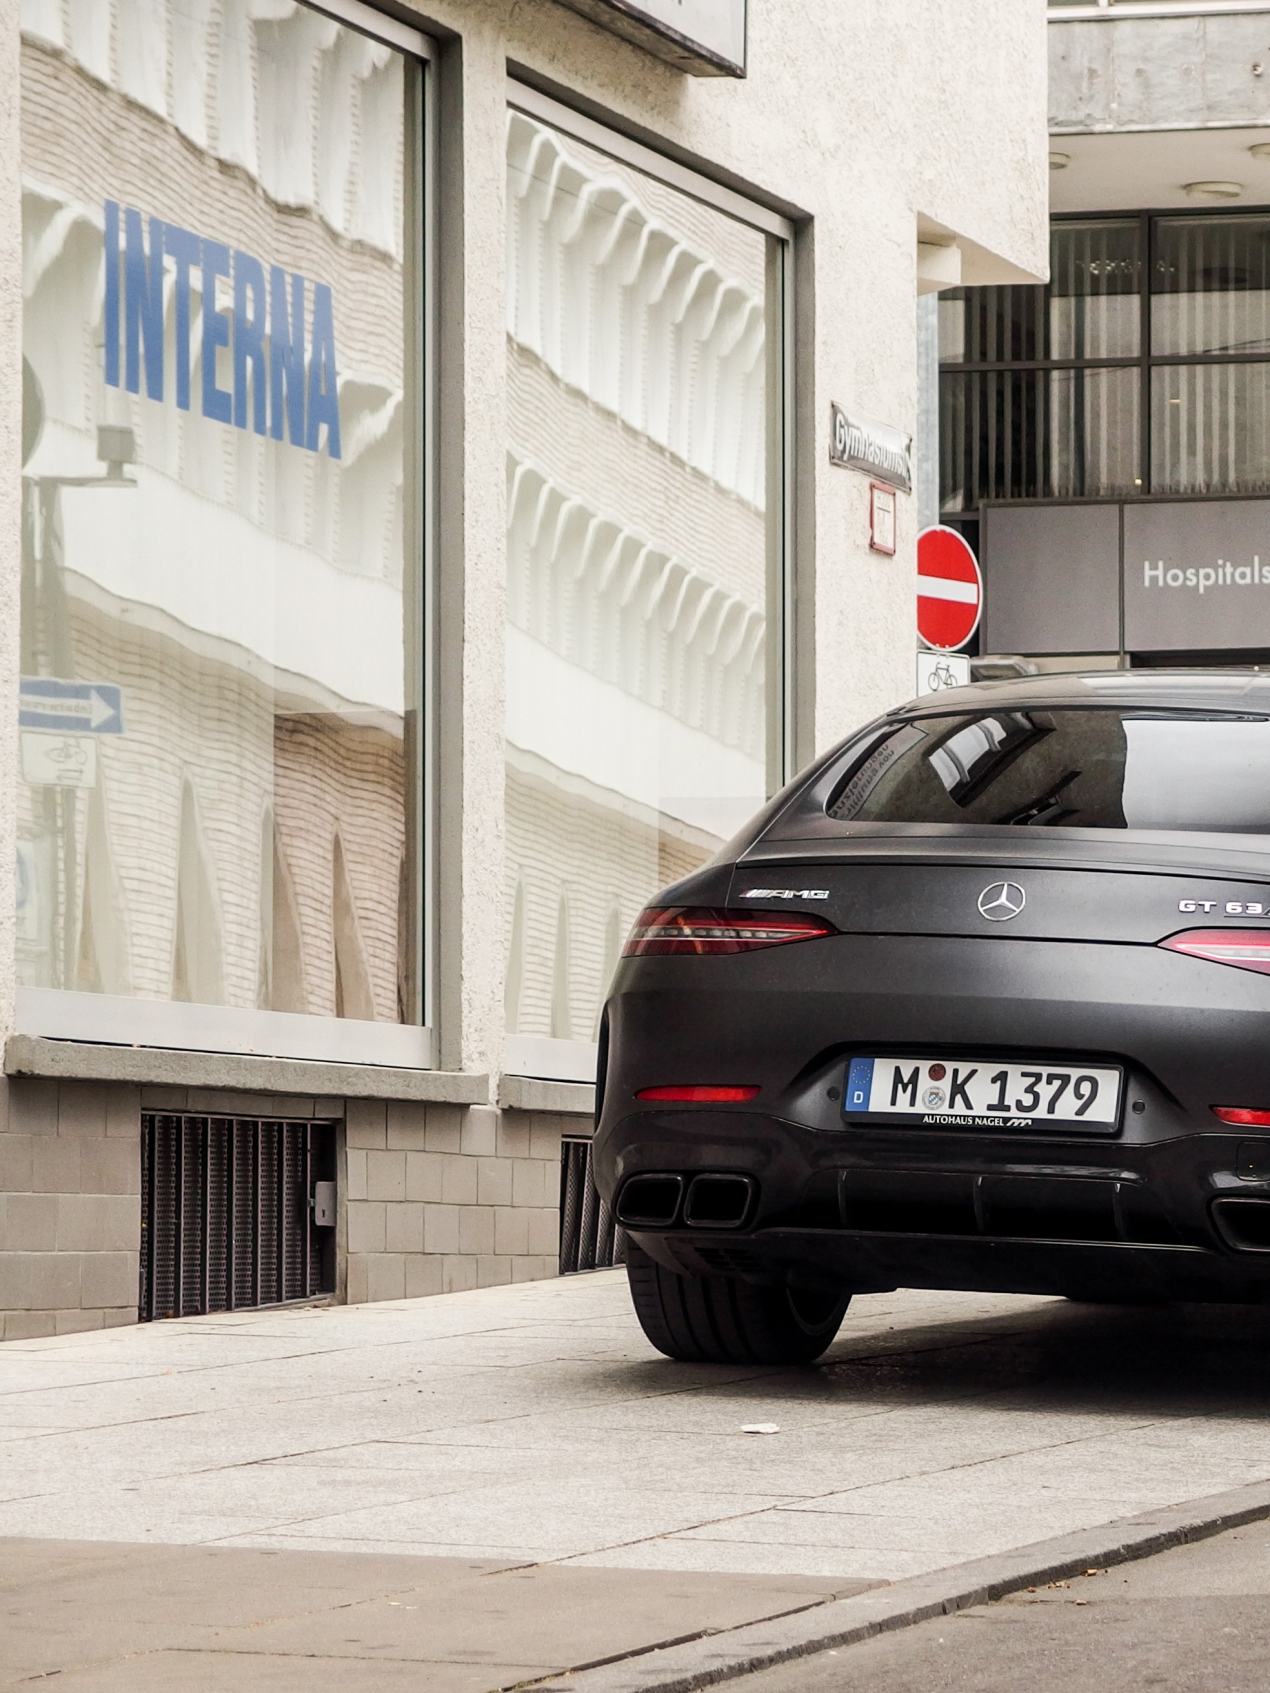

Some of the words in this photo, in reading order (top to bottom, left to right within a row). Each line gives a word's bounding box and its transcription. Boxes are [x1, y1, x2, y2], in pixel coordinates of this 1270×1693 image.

[104, 198, 341, 460] INTERNA
[764, 889, 829, 899] AMG
[1178, 900, 1217, 914] GT
[853, 1091, 863, 1104] D
[922, 1114, 973, 1125] AUTOHAUS
[974, 1116, 1004, 1127] NAGEL
